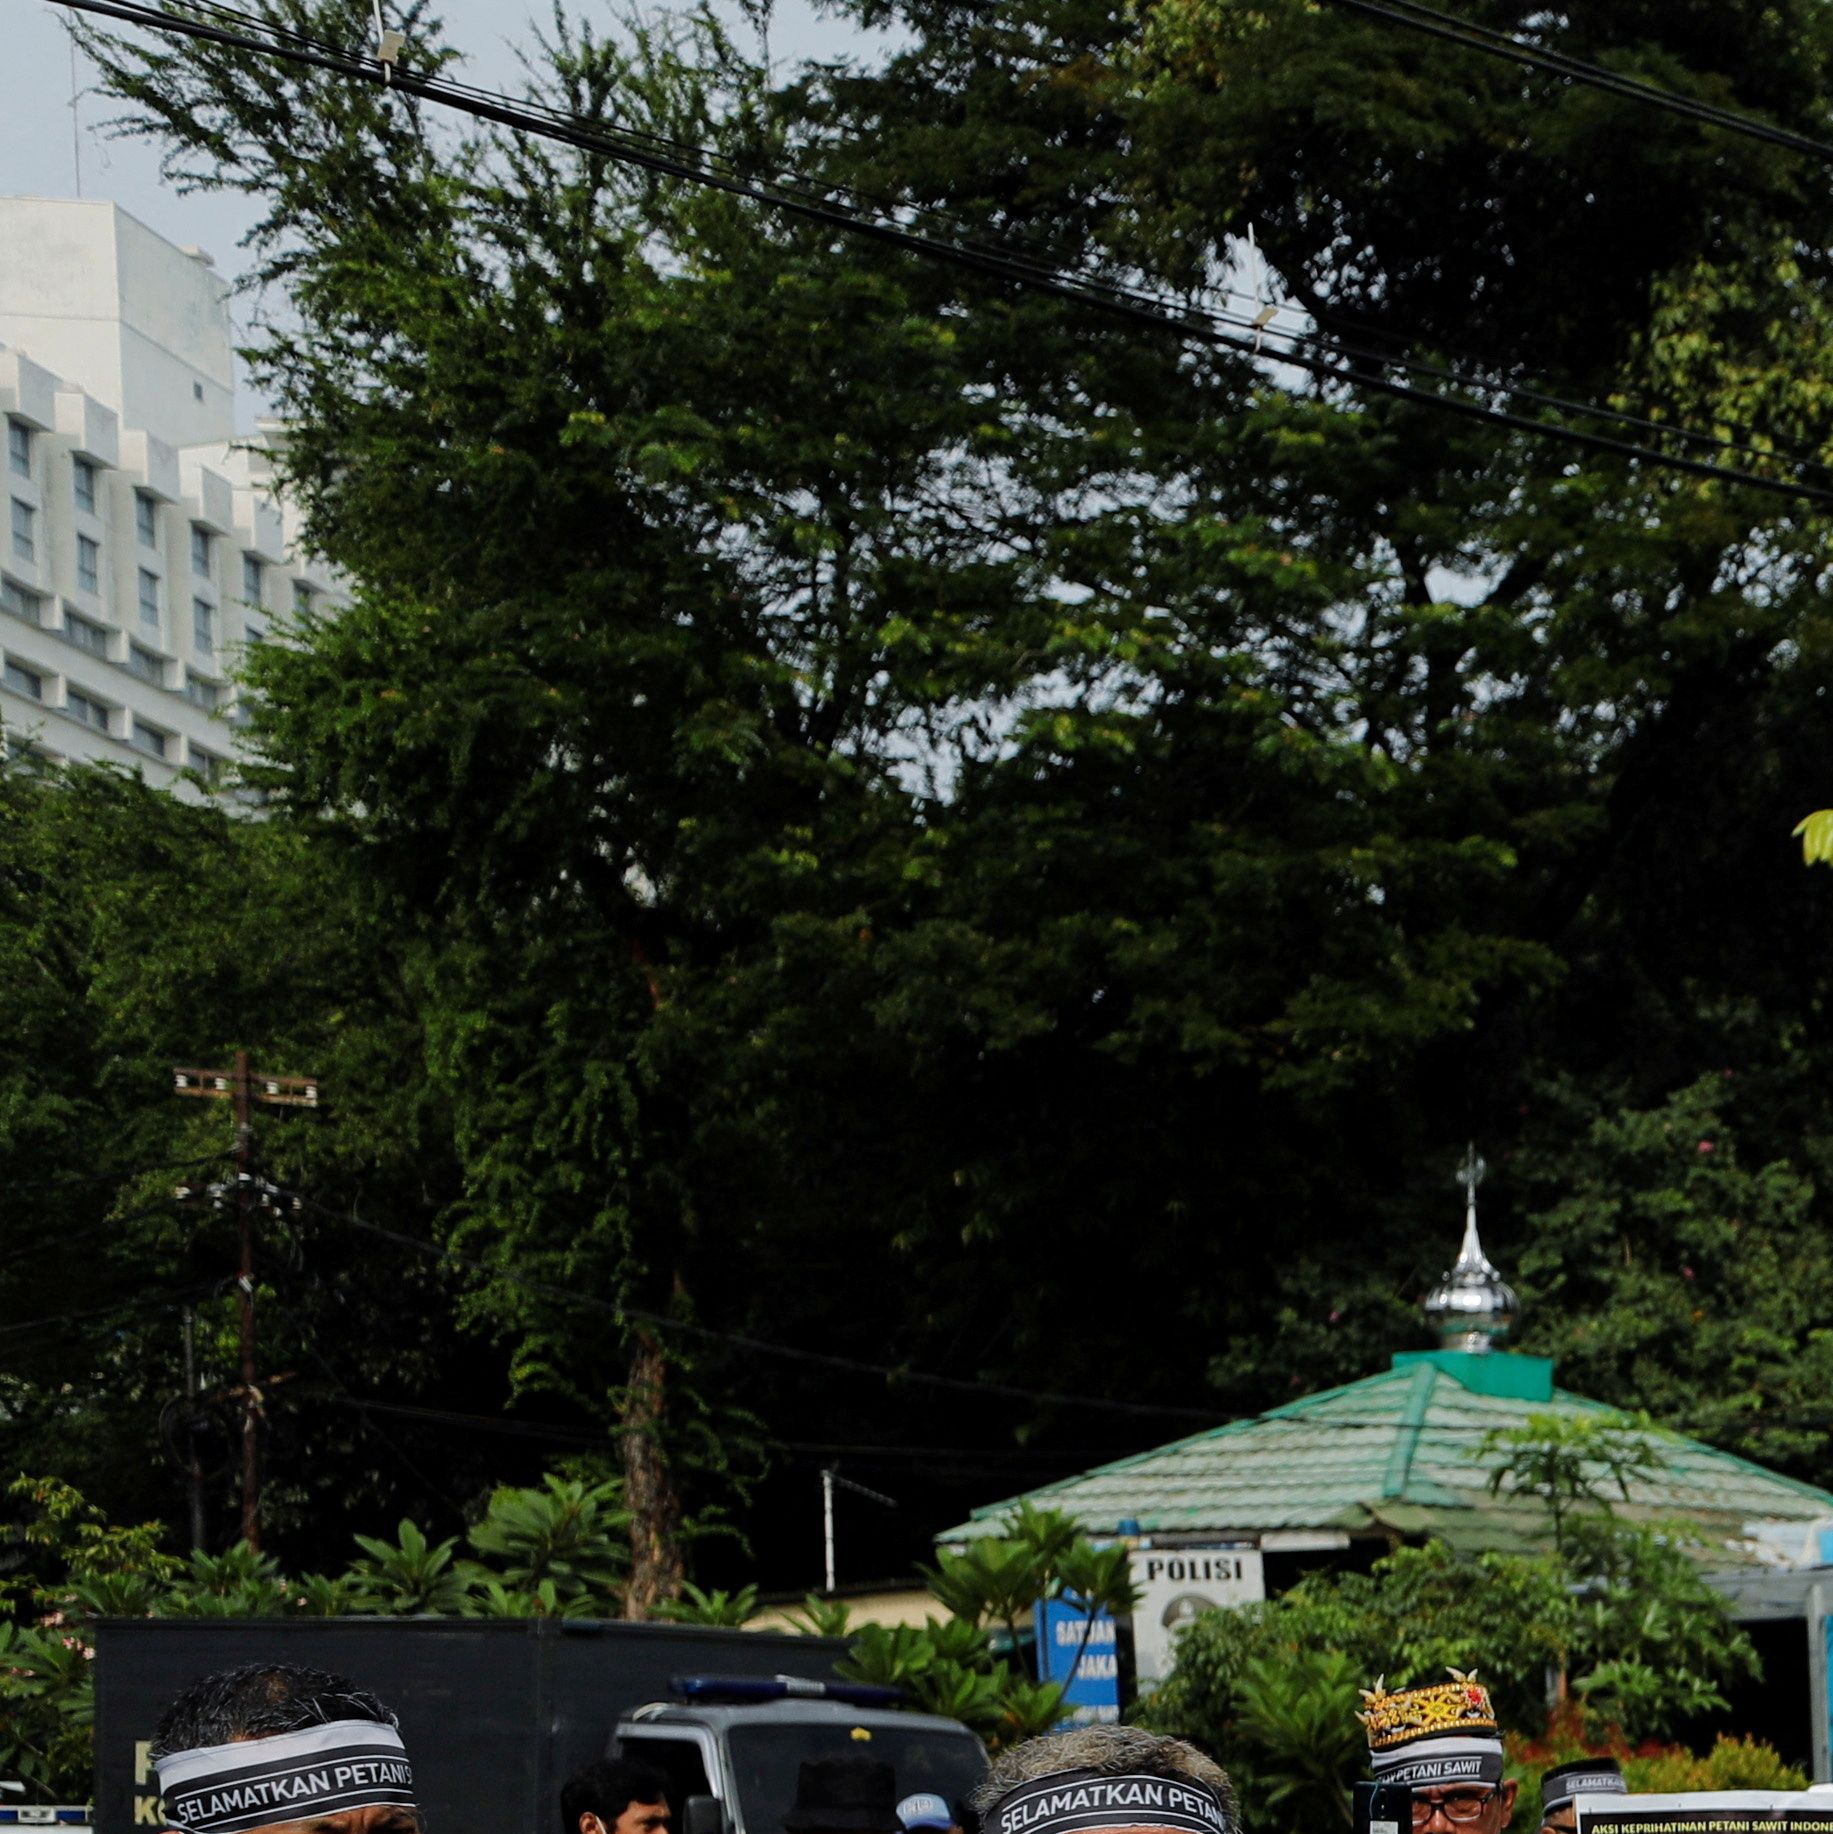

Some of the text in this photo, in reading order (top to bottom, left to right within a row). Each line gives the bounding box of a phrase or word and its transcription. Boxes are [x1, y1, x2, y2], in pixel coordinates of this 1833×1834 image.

[1147, 1558, 1243, 1582] POLISI
[1395, 1762, 1442, 1784] PETANI
[1444, 1759, 1482, 1777] SAWIT
[176, 1770, 331, 1825] SELAMATKAN
[333, 1760, 406, 1790] PETANI
[1591, 1824, 1619, 1834] AKSI
[1621, 1822, 1707, 1834] KEPRIHATINAN
[1708, 1820, 1750, 1832] PETANI
[1752, 1820, 1788, 1832] SAWIT
